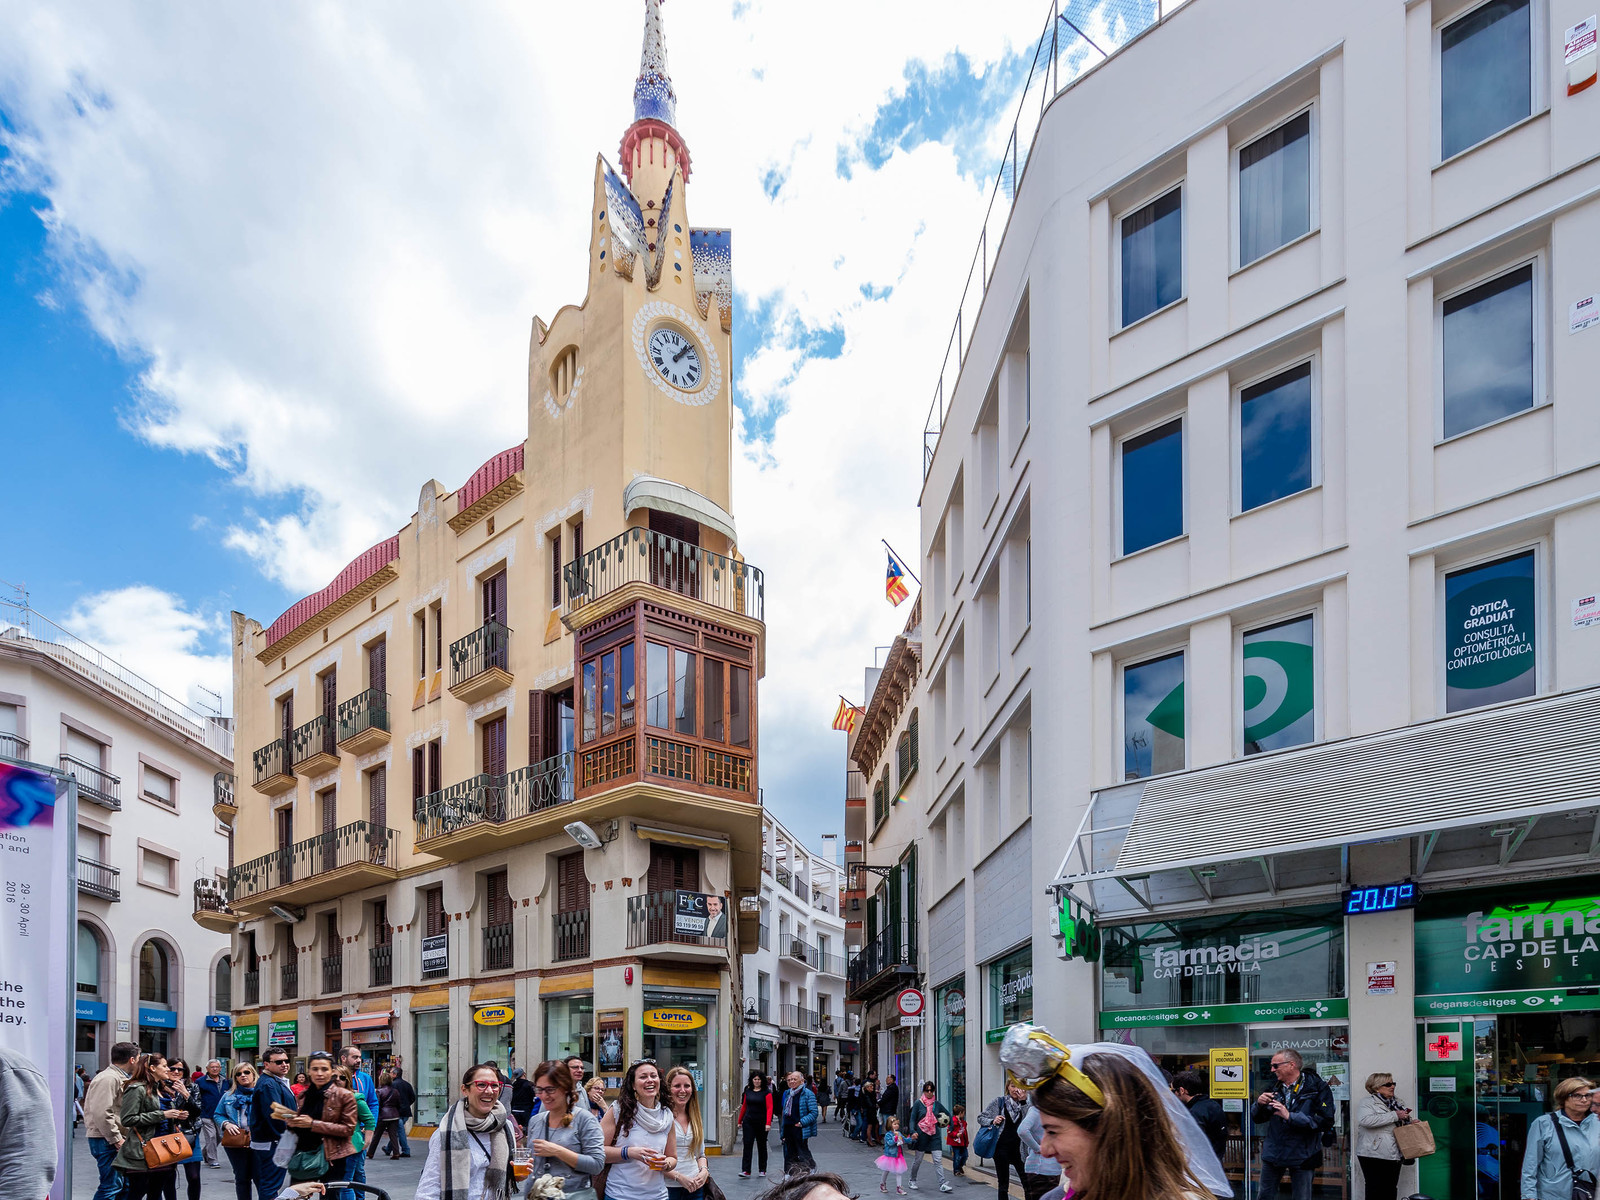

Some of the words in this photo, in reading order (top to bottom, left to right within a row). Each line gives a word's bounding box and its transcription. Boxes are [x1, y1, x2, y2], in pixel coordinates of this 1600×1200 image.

[1469, 599, 1509, 617] ÒPTICA
[1464, 608, 1516, 629] GRADUAT
[1464, 623, 1515, 643] CONSULTA
[1453, 633, 1520, 657] OPTOMÈTRICA
[1522, 632, 1526, 642] I
[1447, 643, 1533, 670] CONTACTOLÒGICA
[8, 845, 30, 854] and
[6, 881, 16, 904] 2016
[20, 883, 31, 895] 29
[20, 902, 30, 915] 30
[17, 916, 30, 937] April
[1152, 937, 1280, 968] farmacia
[1463, 942, 1516, 961] CAP
[1521, 939, 1557, 957] DE
[1563, 936, 1599, 954] LA
[1153, 966, 1181, 979] CAP
[1184, 965, 1203, 977] DE
[1206, 964, 1225, 975] LA
[1228, 961, 1262, 973] VILA
[0, 997, 25, 1009] the
[1254, 1006, 1306, 1016] ecoceutics
[1429, 998, 1517, 1010] degansdesitges
[1114, 1012, 1179, 1023] decanosdesitges
[1271, 1037, 1346, 1050] FARMAOPTICS
